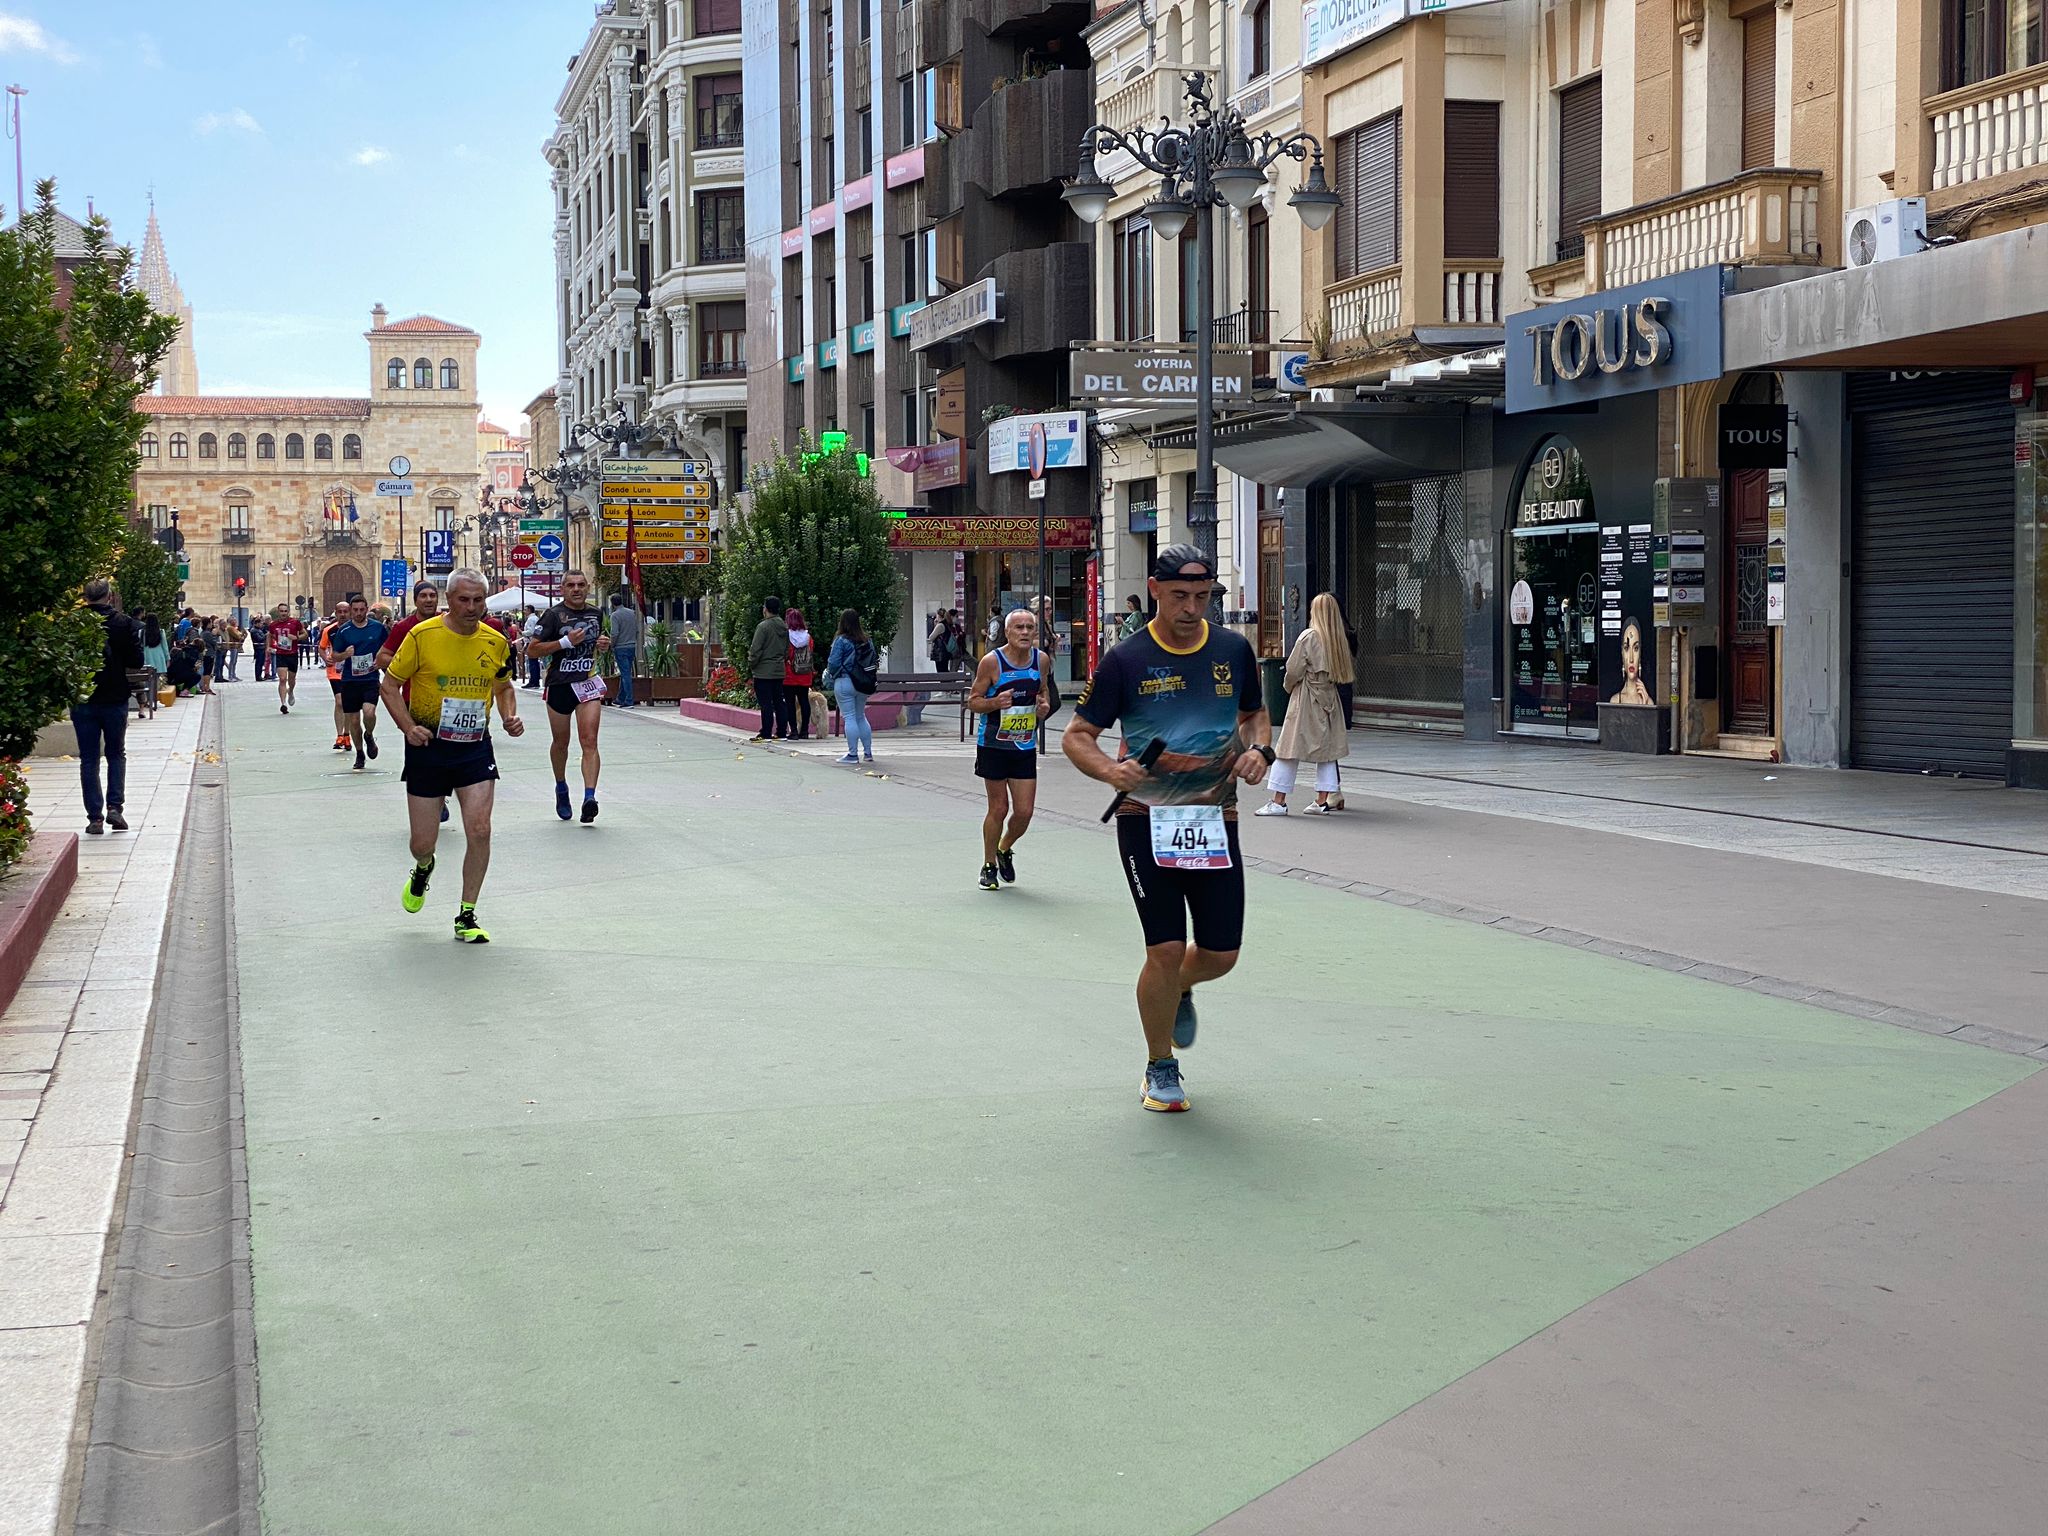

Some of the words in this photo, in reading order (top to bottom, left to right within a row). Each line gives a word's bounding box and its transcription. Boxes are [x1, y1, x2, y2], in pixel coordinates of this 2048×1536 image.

[1524, 297, 1672, 386] TOUS
[1134, 358, 1192, 369] JOYERIA
[1084, 374, 1128, 392] DEL
[1725, 429, 1783, 444] TOUS
[1544, 458, 1559, 477] BE
[378, 481, 412, 491] Cámara
[1130, 500, 1157, 513] ESTRELLA
[1524, 503, 1539, 522] BE
[1540, 499, 1584, 519] BEAUTY
[893, 520, 956, 530] ROYAL
[963, 519, 1067, 531] TANDOORI
[644, 530, 674, 538] Antonio
[429, 531, 442, 554] P
[1580, 584, 1594, 603] BE
[356, 660, 369, 669] 495
[582, 681, 597, 692] 301
[1138, 681, 1187, 694] LANZAROTE
[1215, 684, 1233, 694] OTSO
[452, 713, 477, 728] 466
[1010, 718, 1028, 730] 233
[1171, 828, 1208, 850] 494
[1175, 857, 1210, 868] Coca-Cola
